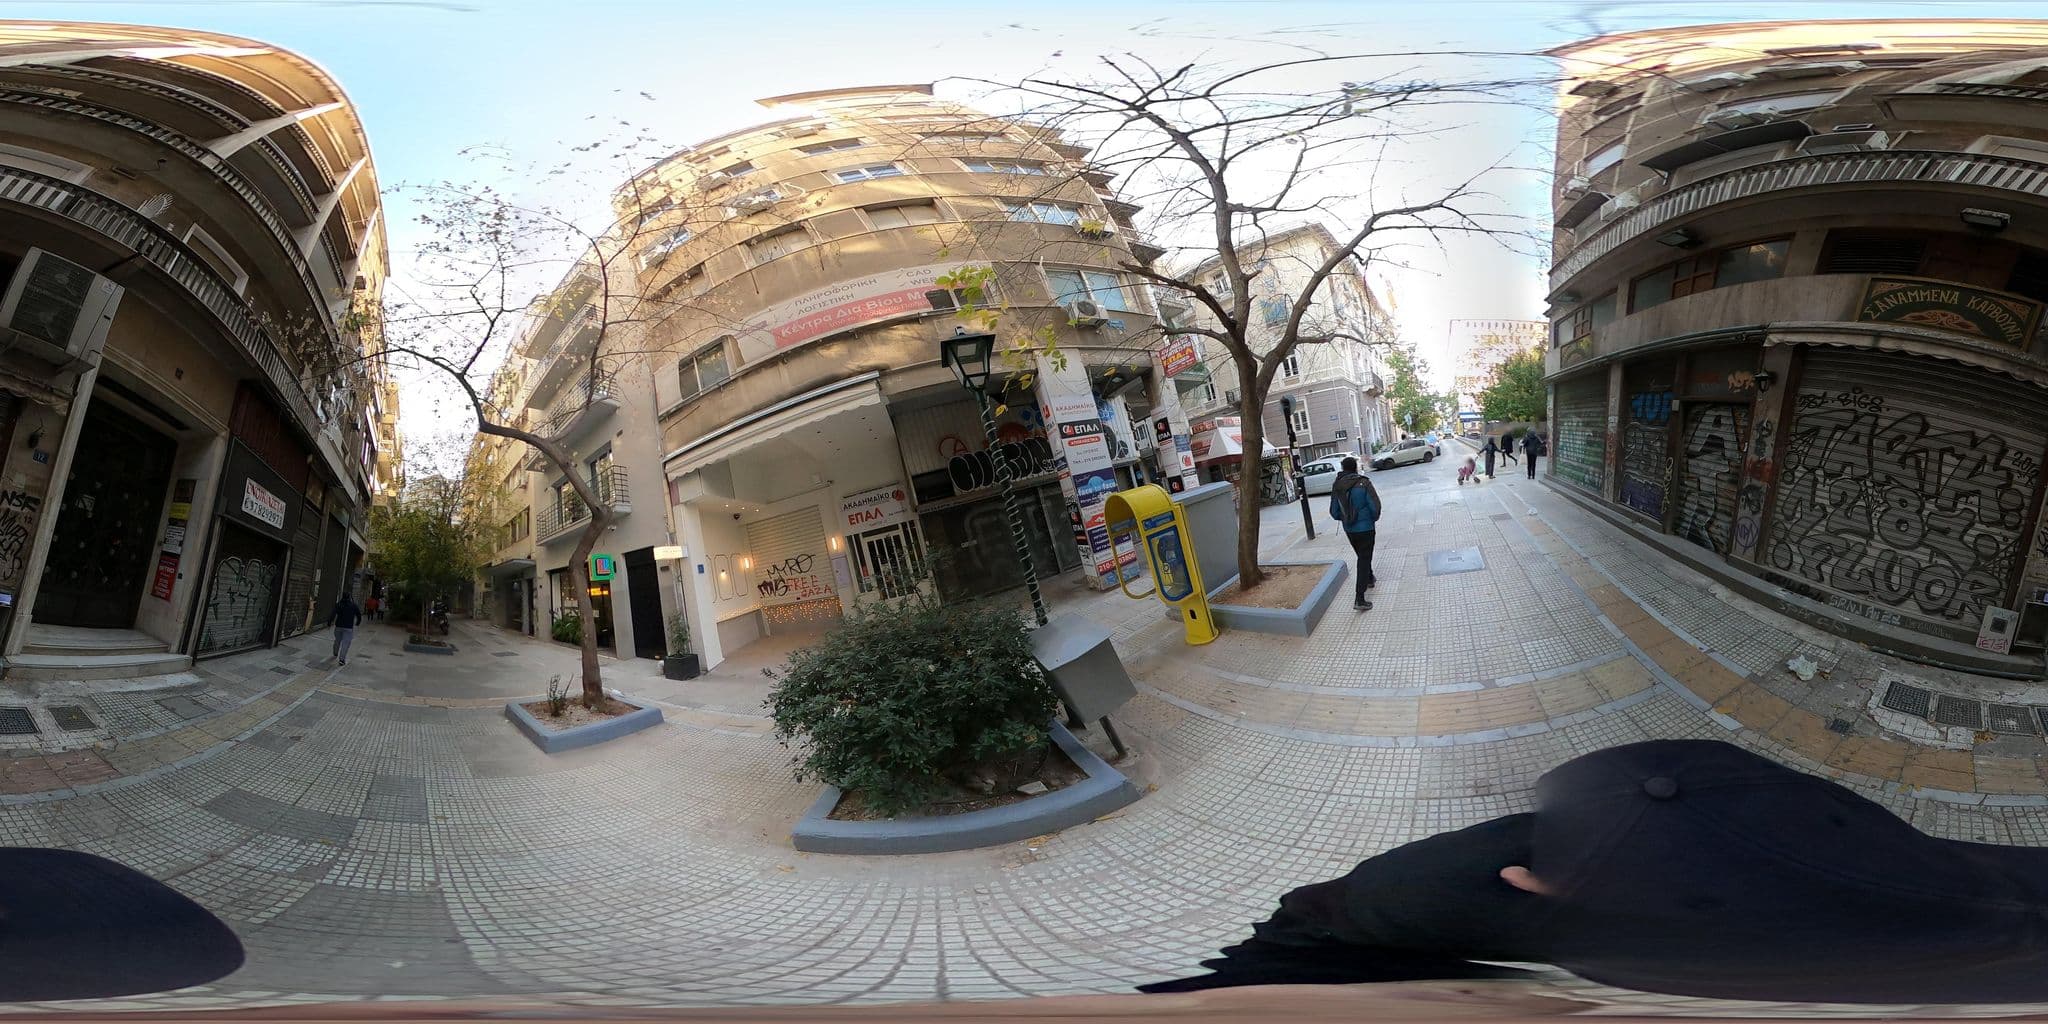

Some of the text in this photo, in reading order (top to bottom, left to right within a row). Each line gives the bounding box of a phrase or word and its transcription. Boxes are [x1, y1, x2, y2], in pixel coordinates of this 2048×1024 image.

[906, 269, 932, 278] CAD
[794, 278, 878, 306] ΠΛΗΡΟΦΟΡΙΚΗ
[797, 293, 855, 316] ΛΟΓΙΣΤΙΚΗ
[781, 314, 832, 338] Κέντρα
[836, 306, 862, 320] Δια
[866, 295, 903, 310] Βίου
[1074, 423, 1099, 434] ΕΠΑΛ
[848, 507, 884, 526] ΕΠΑΛ
[786, 575, 820, 592] FREE
